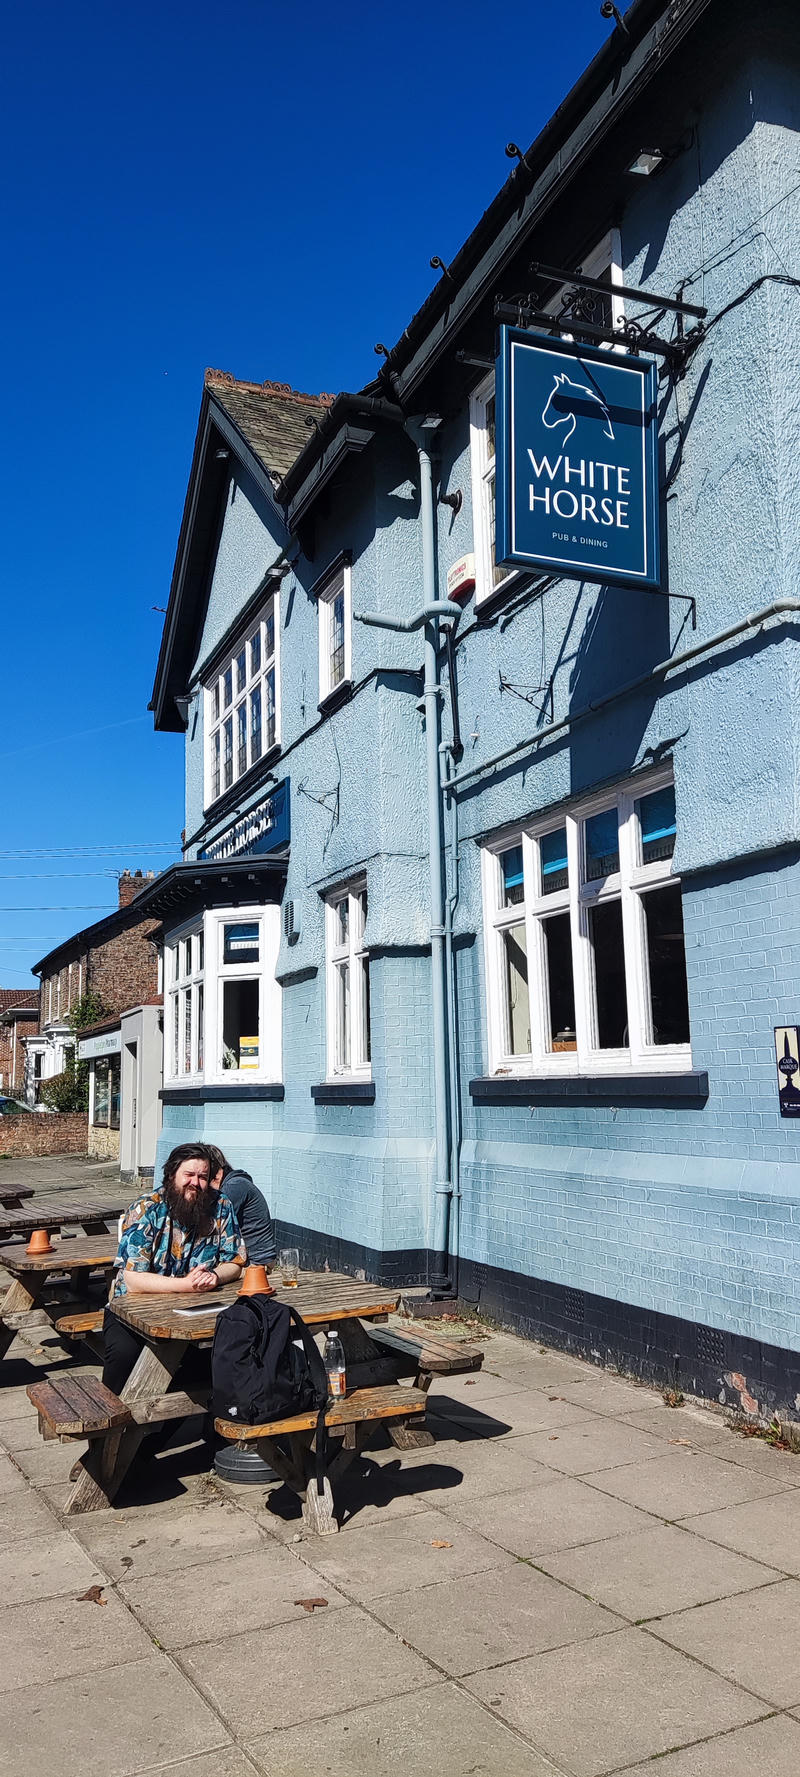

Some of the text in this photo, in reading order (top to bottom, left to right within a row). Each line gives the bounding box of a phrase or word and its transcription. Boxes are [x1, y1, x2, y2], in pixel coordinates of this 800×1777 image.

[527, 448, 631, 495] WHITE
[529, 484, 630, 528] HORSE
[552, 532, 608, 549] PUB & DINING
